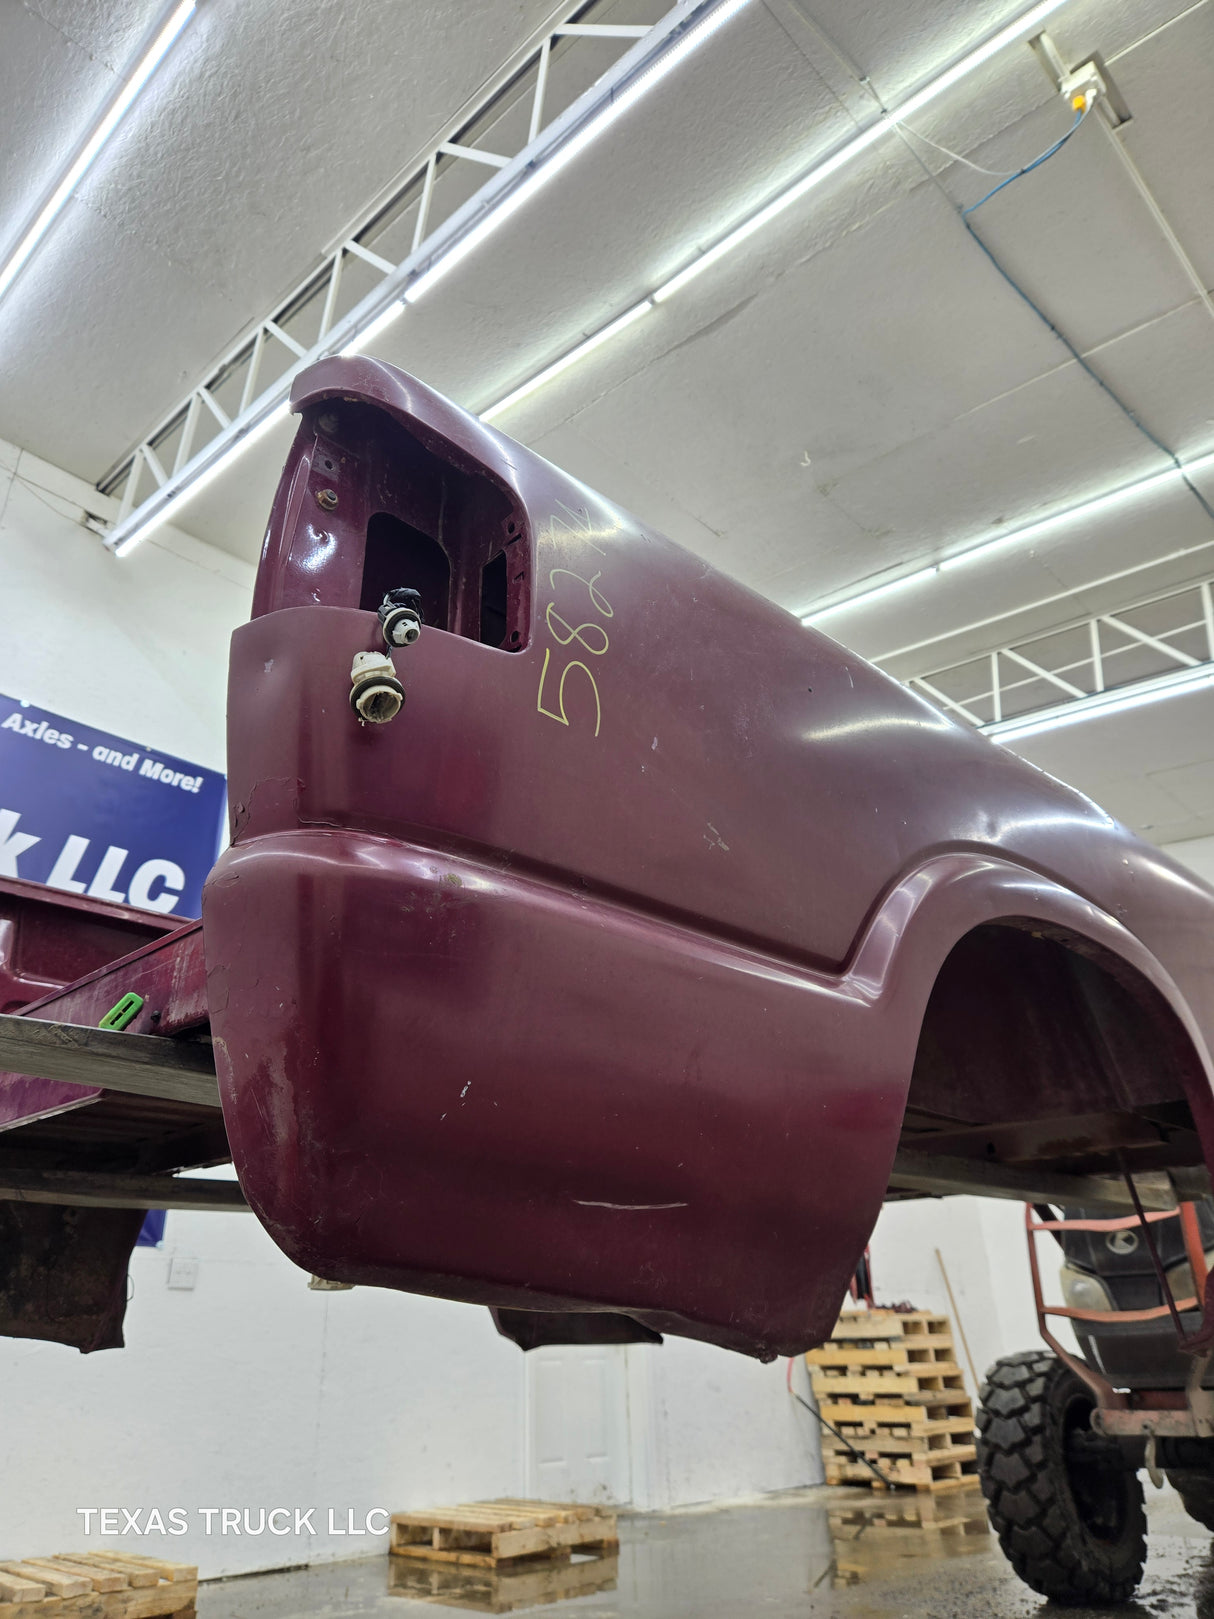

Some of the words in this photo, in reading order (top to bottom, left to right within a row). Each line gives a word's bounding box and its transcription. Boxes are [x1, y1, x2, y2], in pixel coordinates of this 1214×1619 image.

[1, 713, 74, 749] Axles
[92, 745, 140, 771] and
[139, 759, 204, 793] More!
[46, 834, 186, 914] LLC
